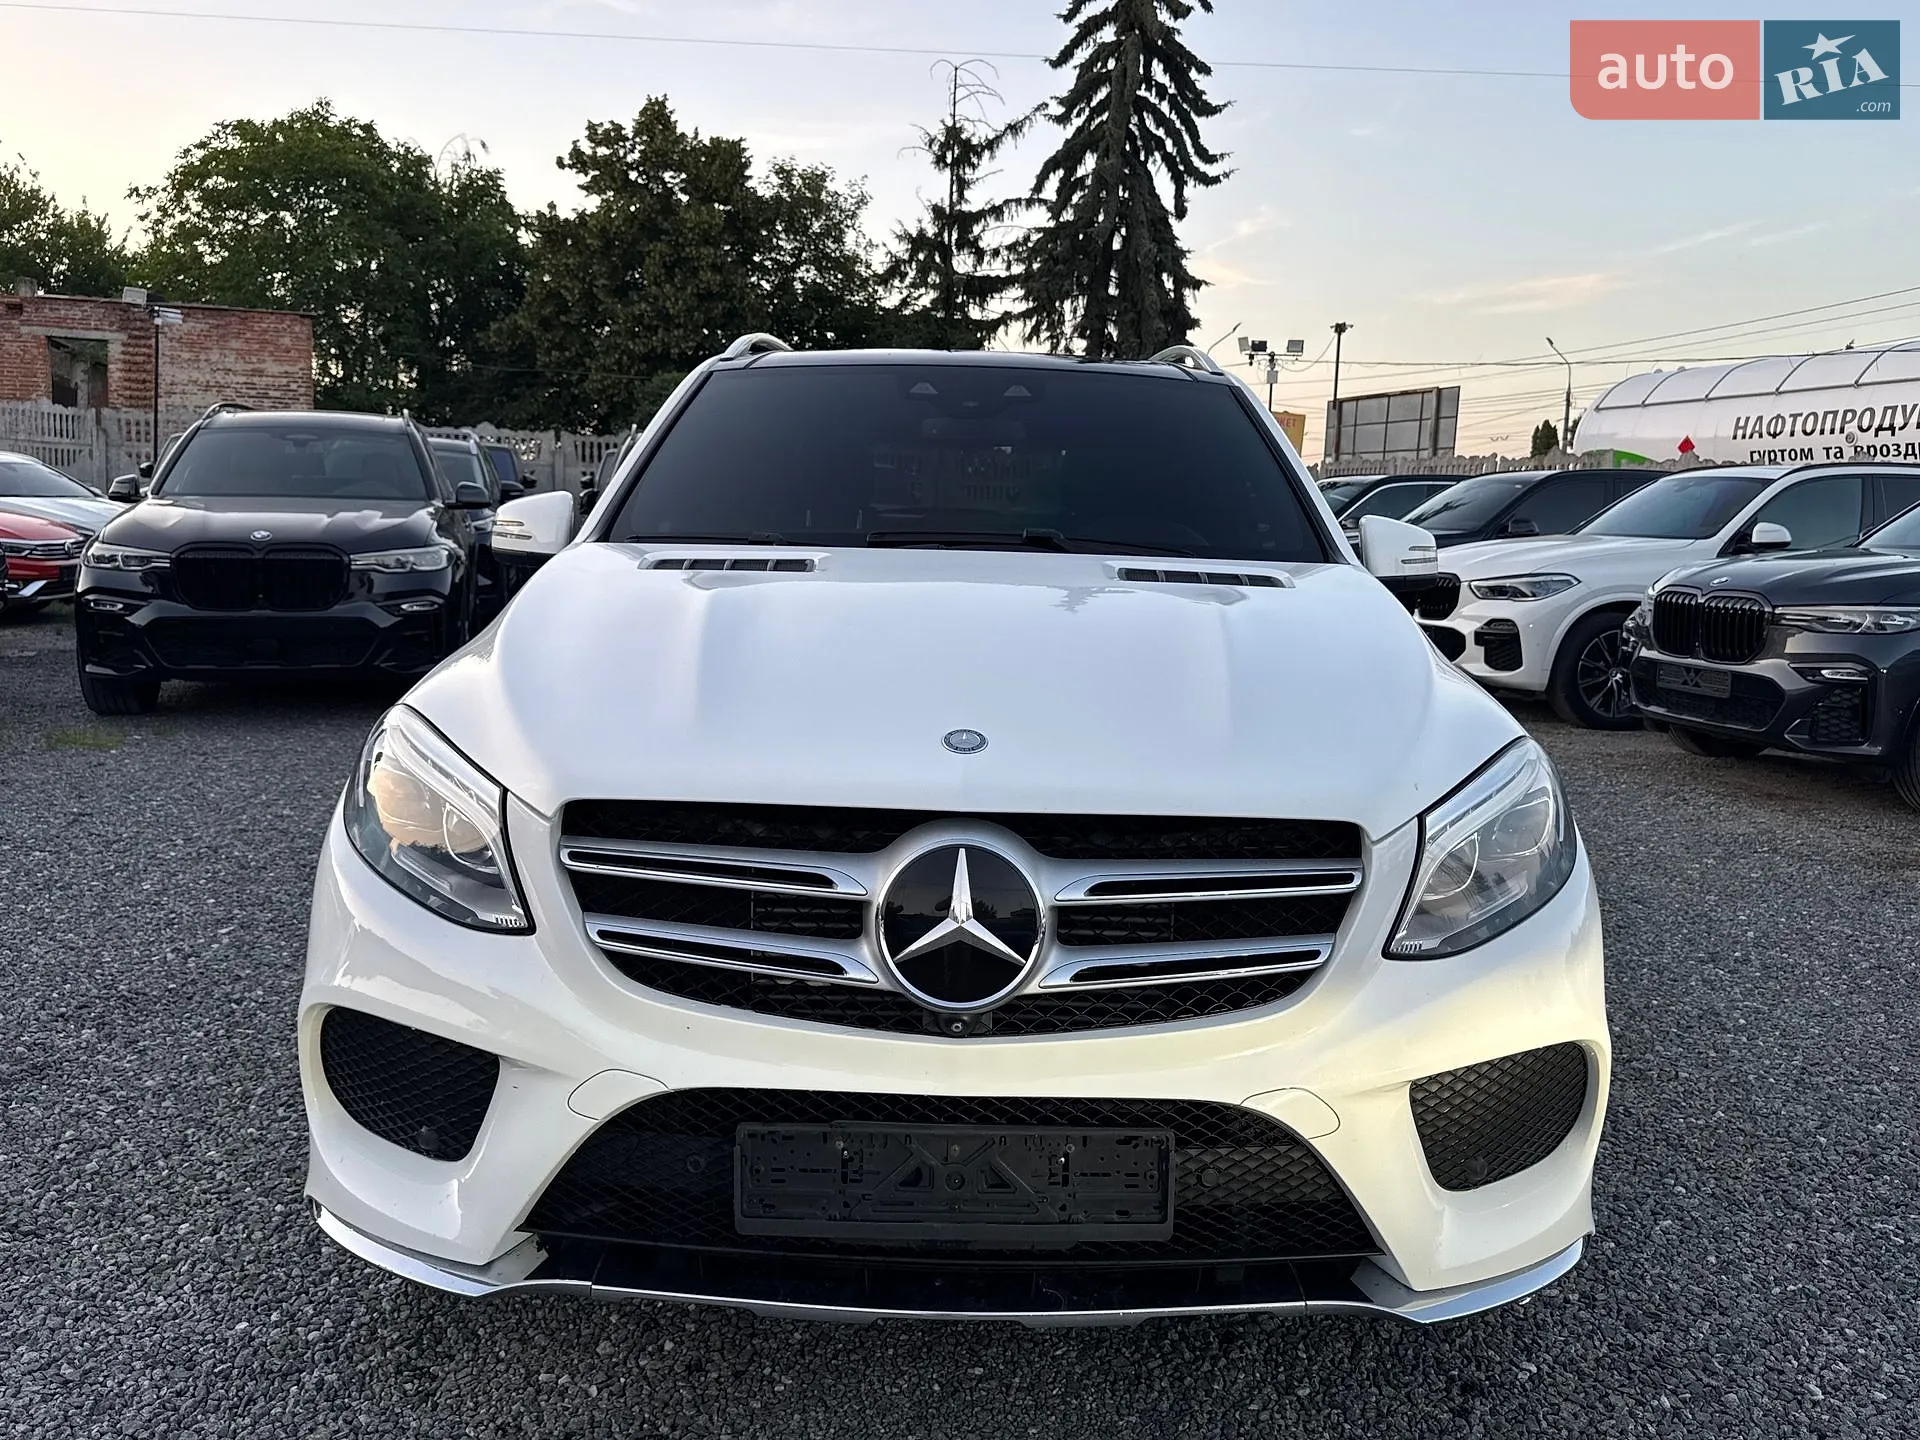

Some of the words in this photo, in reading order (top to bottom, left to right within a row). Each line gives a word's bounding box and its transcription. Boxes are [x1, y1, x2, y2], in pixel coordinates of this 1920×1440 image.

[1749, 447, 1815, 464] гуртом
[1823, 446, 1844, 460] та
[1853, 442, 1920, 461] врозд
